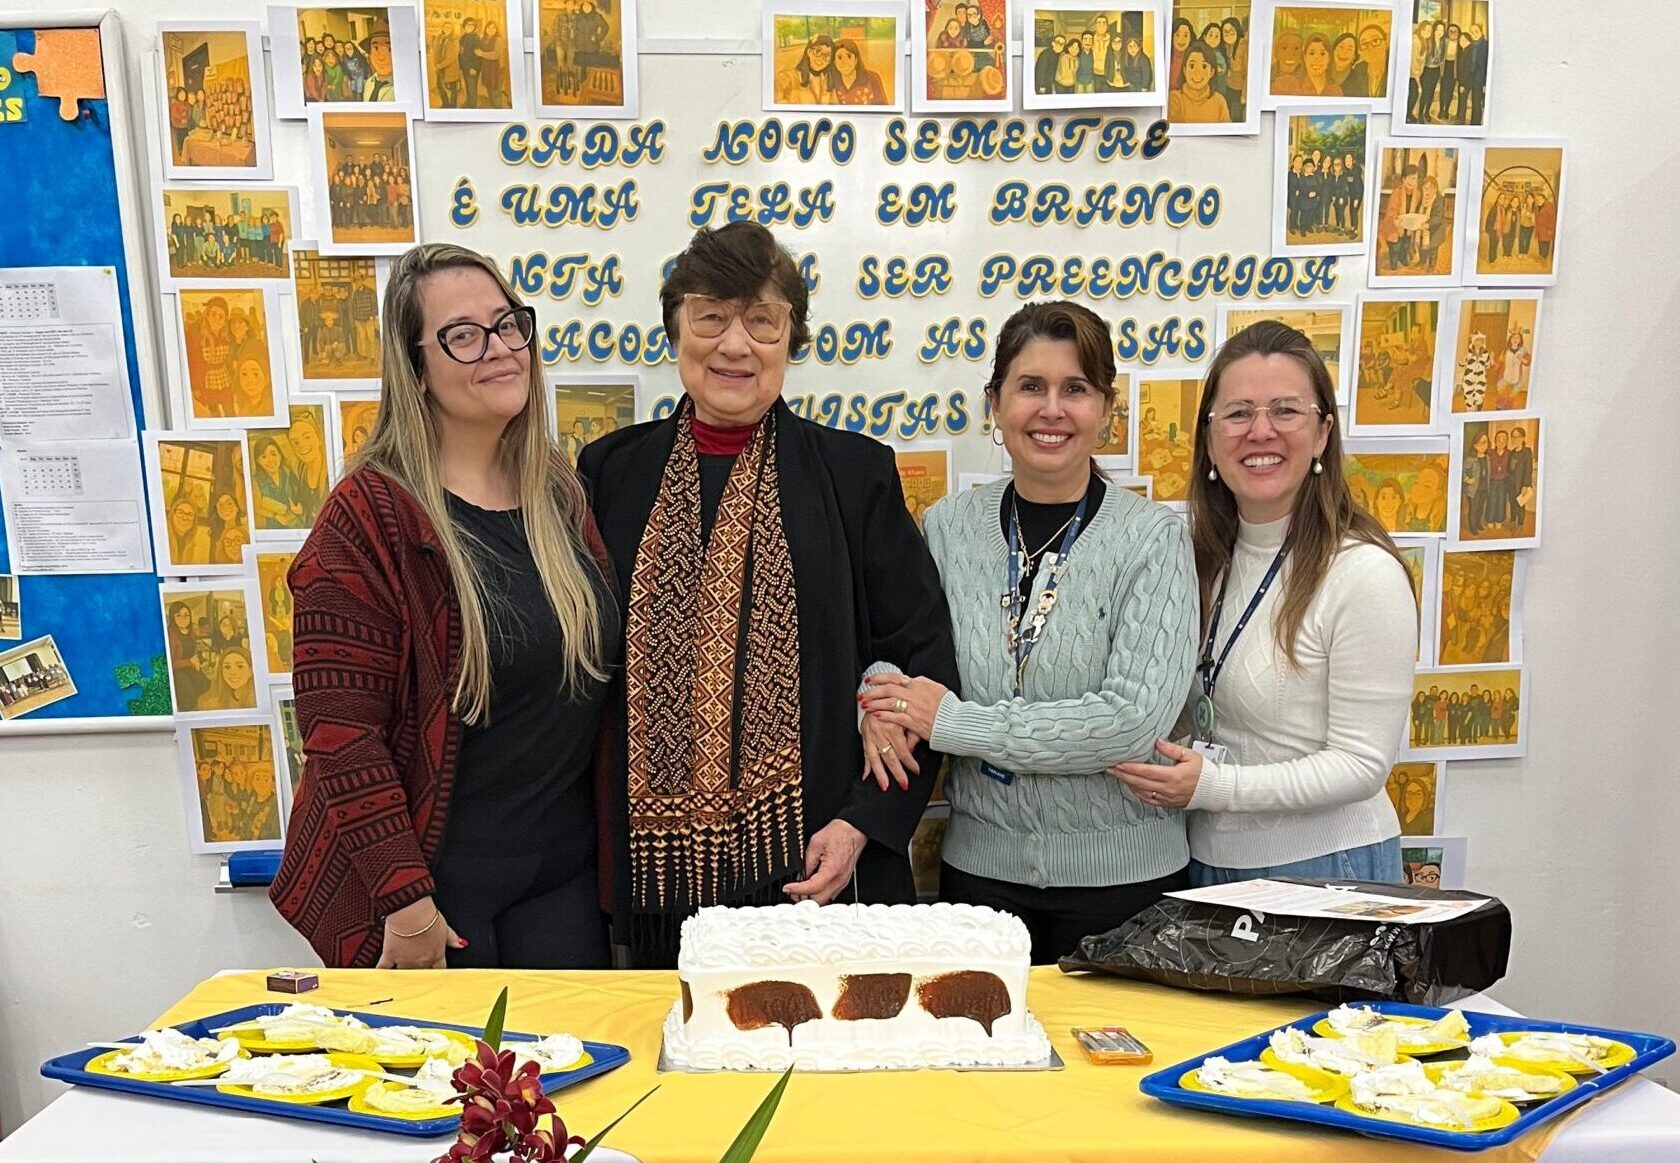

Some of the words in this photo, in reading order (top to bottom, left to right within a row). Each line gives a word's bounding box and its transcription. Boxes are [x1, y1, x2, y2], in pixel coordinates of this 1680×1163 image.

[500, 119, 666, 169] CADA
[702, 118, 856, 166] NOVO
[883, 116, 1170, 165] SEMESTRE
[449, 175, 479, 229] É
[500, 177, 639, 230] UMA
[688, 179, 836, 229] TELA
[876, 181, 957, 226] EM
[989, 179, 1222, 228] BRANCO
[856, 254, 953, 300] SER
[978, 252, 1339, 300] PREENCHIDA
[541, 319, 680, 365] ACOR
[918, 316, 988, 363] AS
